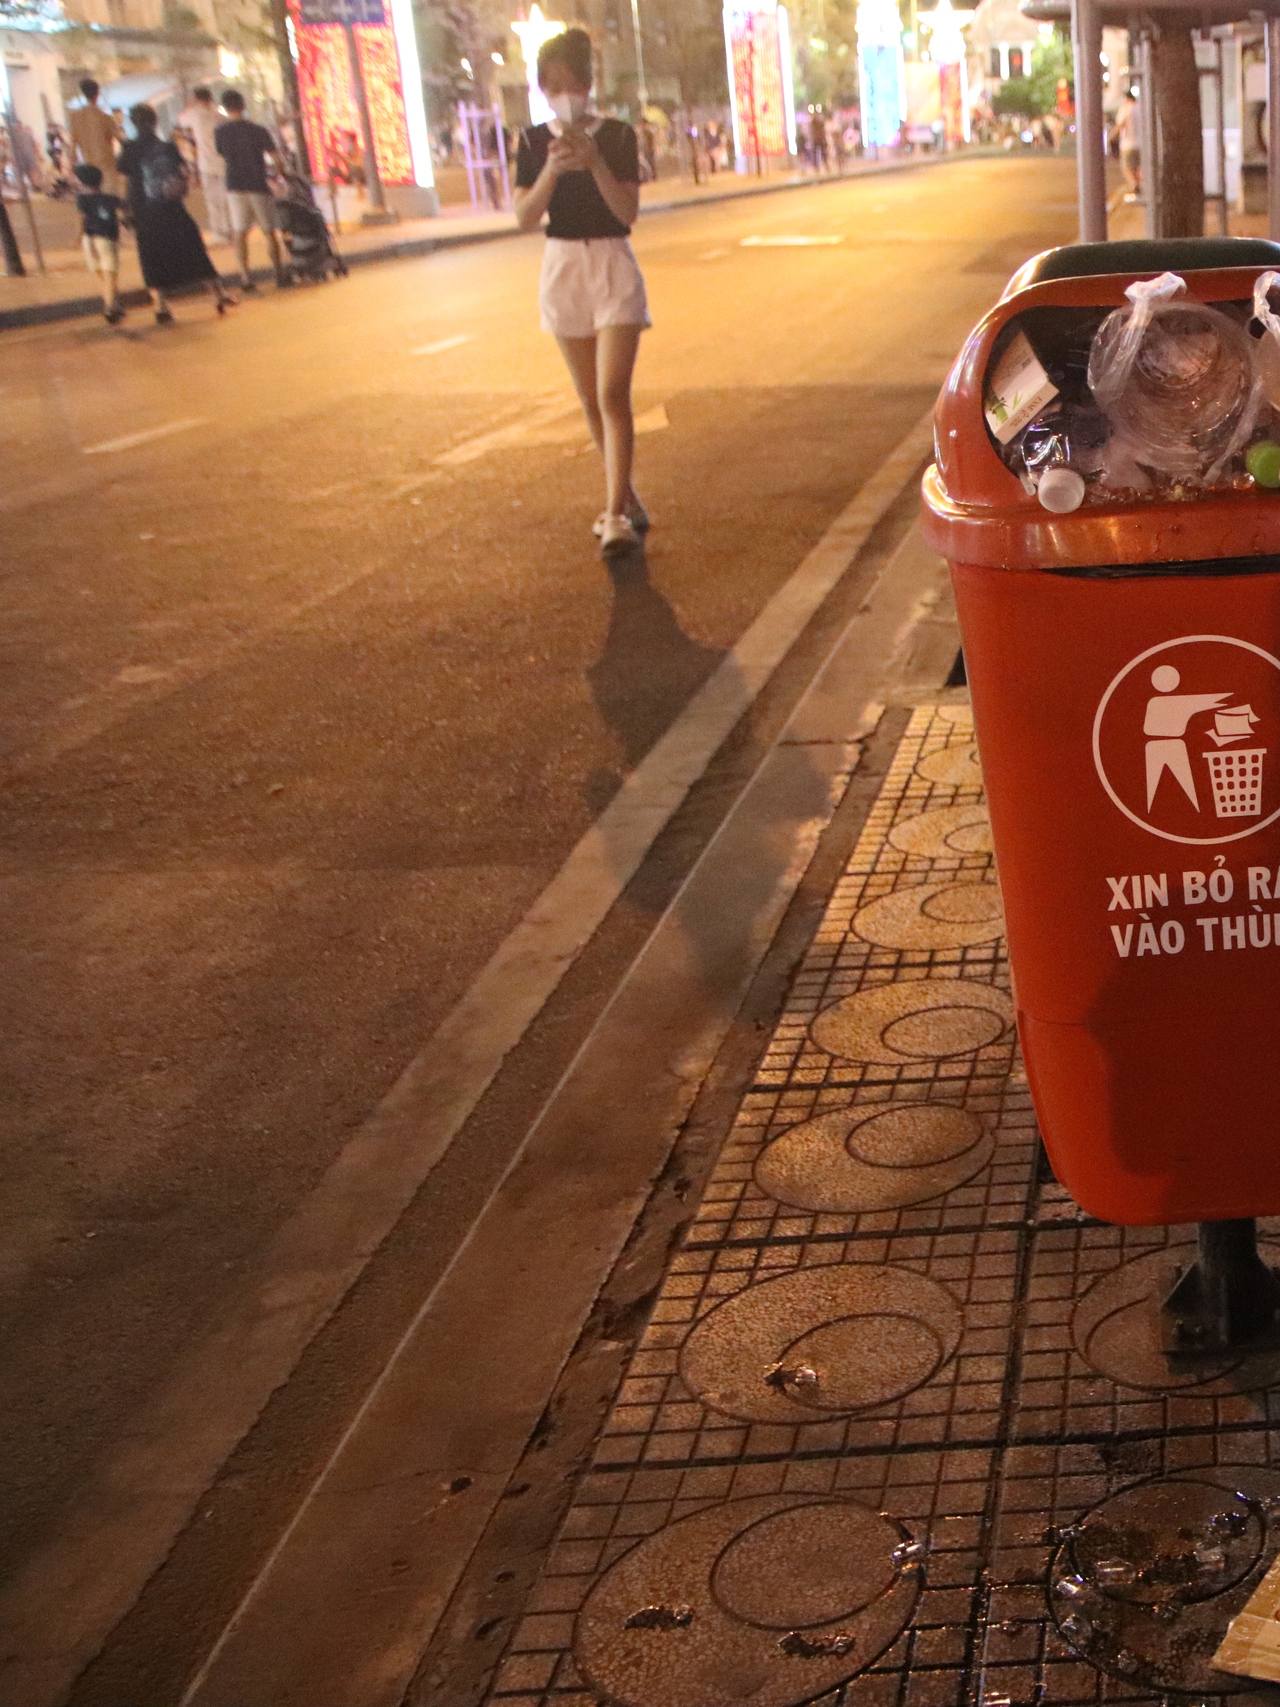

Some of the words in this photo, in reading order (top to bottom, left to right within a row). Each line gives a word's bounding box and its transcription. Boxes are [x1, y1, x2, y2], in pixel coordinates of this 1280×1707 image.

[1105, 872, 1169, 912] XIN
[1182, 854, 1234, 906] BỎ
[1110, 912, 1186, 958] VÀO
